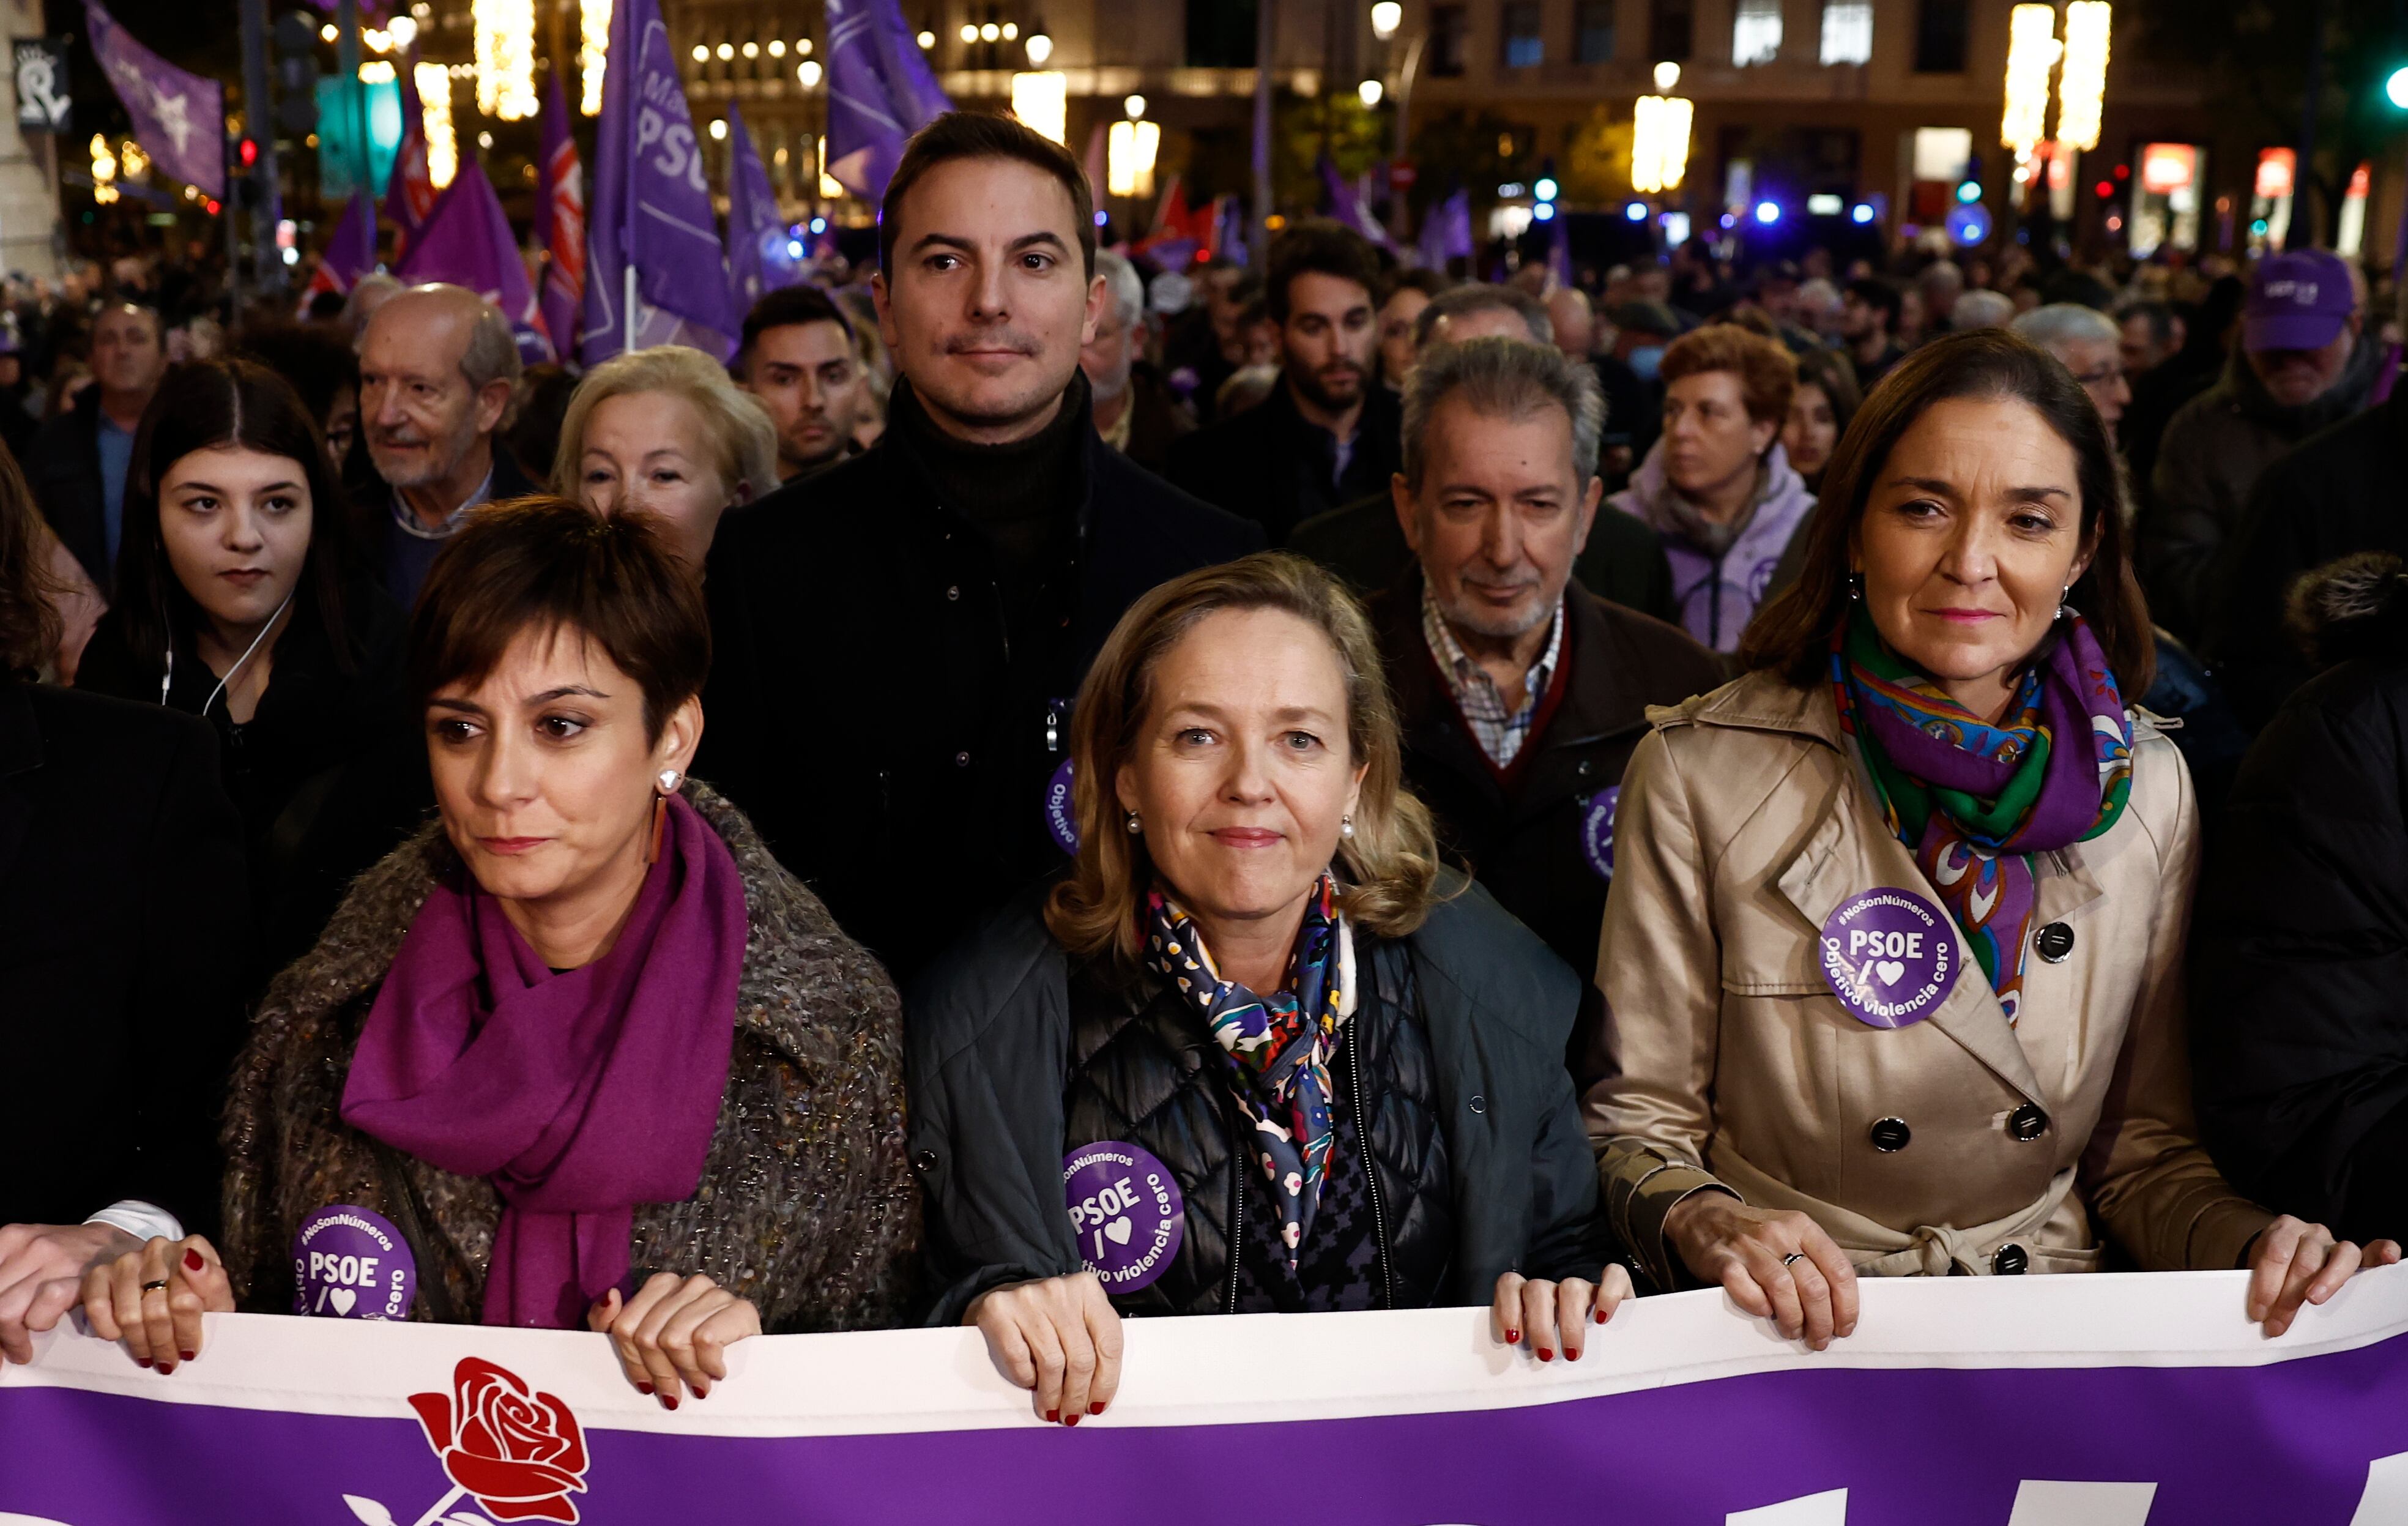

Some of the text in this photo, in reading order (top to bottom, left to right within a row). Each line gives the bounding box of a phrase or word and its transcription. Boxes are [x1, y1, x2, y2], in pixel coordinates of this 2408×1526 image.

[1049, 784, 1075, 843] Objetivo
[1837, 895, 1935, 927] #NoSonNúmeros
[1849, 929, 1923, 959] PSOE
[1824, 937, 1949, 1017] Objetivo violencia cero
[1063, 1152, 1134, 1184] onNúmeros
[1068, 1176, 1141, 1235] PSOE
[300, 1213, 393, 1252] #NoSonNúmeros
[1112, 1219, 1172, 1282] violencia
[1146, 1173, 1172, 1215] cero
[310, 1251, 379, 1287] PSOE
[385, 1269, 405, 1314] cero
